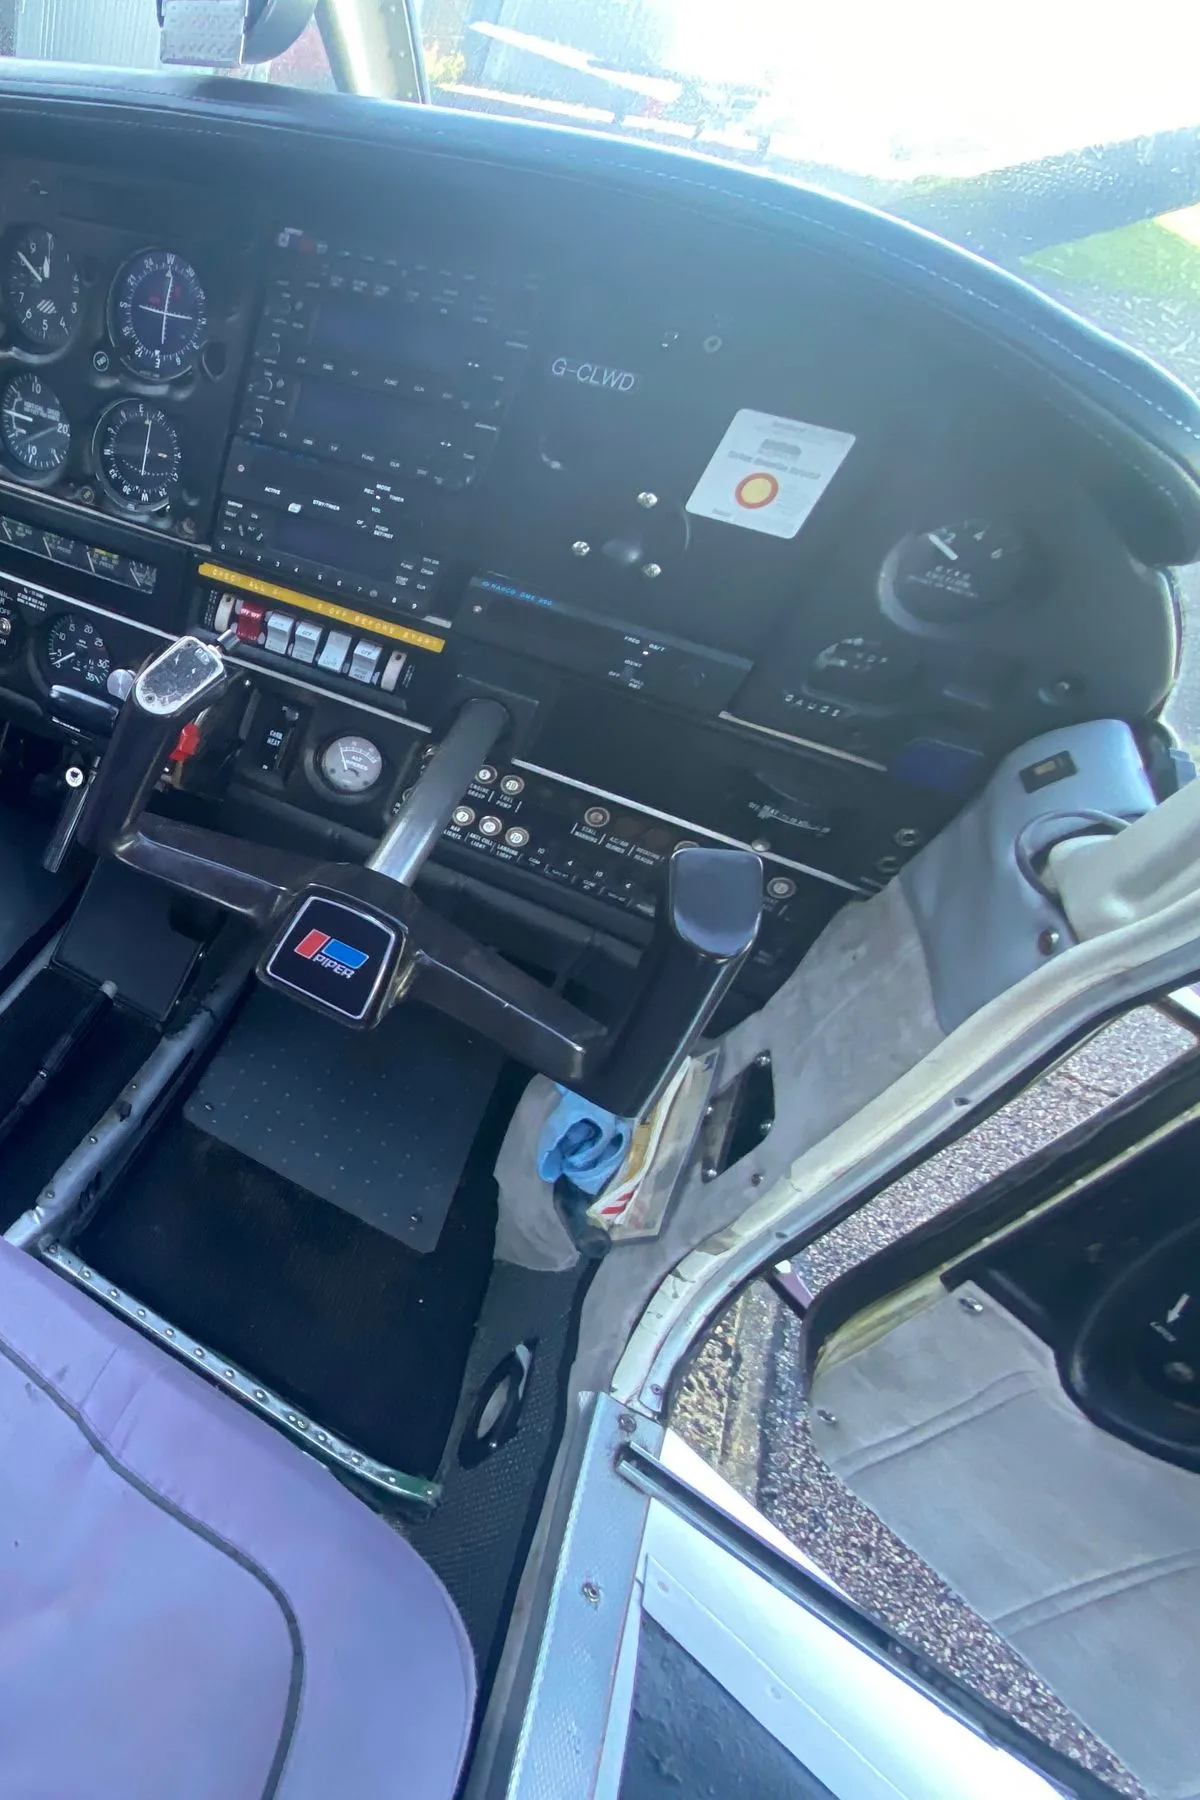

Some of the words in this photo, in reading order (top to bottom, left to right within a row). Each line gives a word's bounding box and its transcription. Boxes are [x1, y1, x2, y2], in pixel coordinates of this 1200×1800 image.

[552, 357, 635, 392] G-CLWD
[32, 383, 42, 394] 10
[56, 422, 68, 434] 20
[28, 444, 37, 456] 10
[362, 453, 375, 462] FUNC
[264, 486, 281, 496] ACTIVE
[364, 488, 375, 496] REC
[376, 483, 392, 492] MODE
[388, 494, 404, 503] TIMER
[371, 506, 382, 514] VOL
[944, 532, 956, 544] 2
[275, 560, 281, 568] 3
[400, 562, 414, 571] FUNC
[0, 607, 12, 616] OFF
[68, 624, 76, 632] 15
[84, 624, 93, 634] 20
[94, 638, 104, 647] 25
[97, 658, 107, 670] 30
[624, 658, 643, 668] IDENT
[86, 672, 95, 682] 35
[266, 736, 282, 748] HEAT
[496, 799, 513, 810] PUMP
[443, 829, 462, 842] LIGHTS
[470, 840, 487, 851] LIGHT
[496, 850, 514, 861] LIGHT
[568, 860, 574, 868] 4
[312, 955, 356, 980] PIPER
